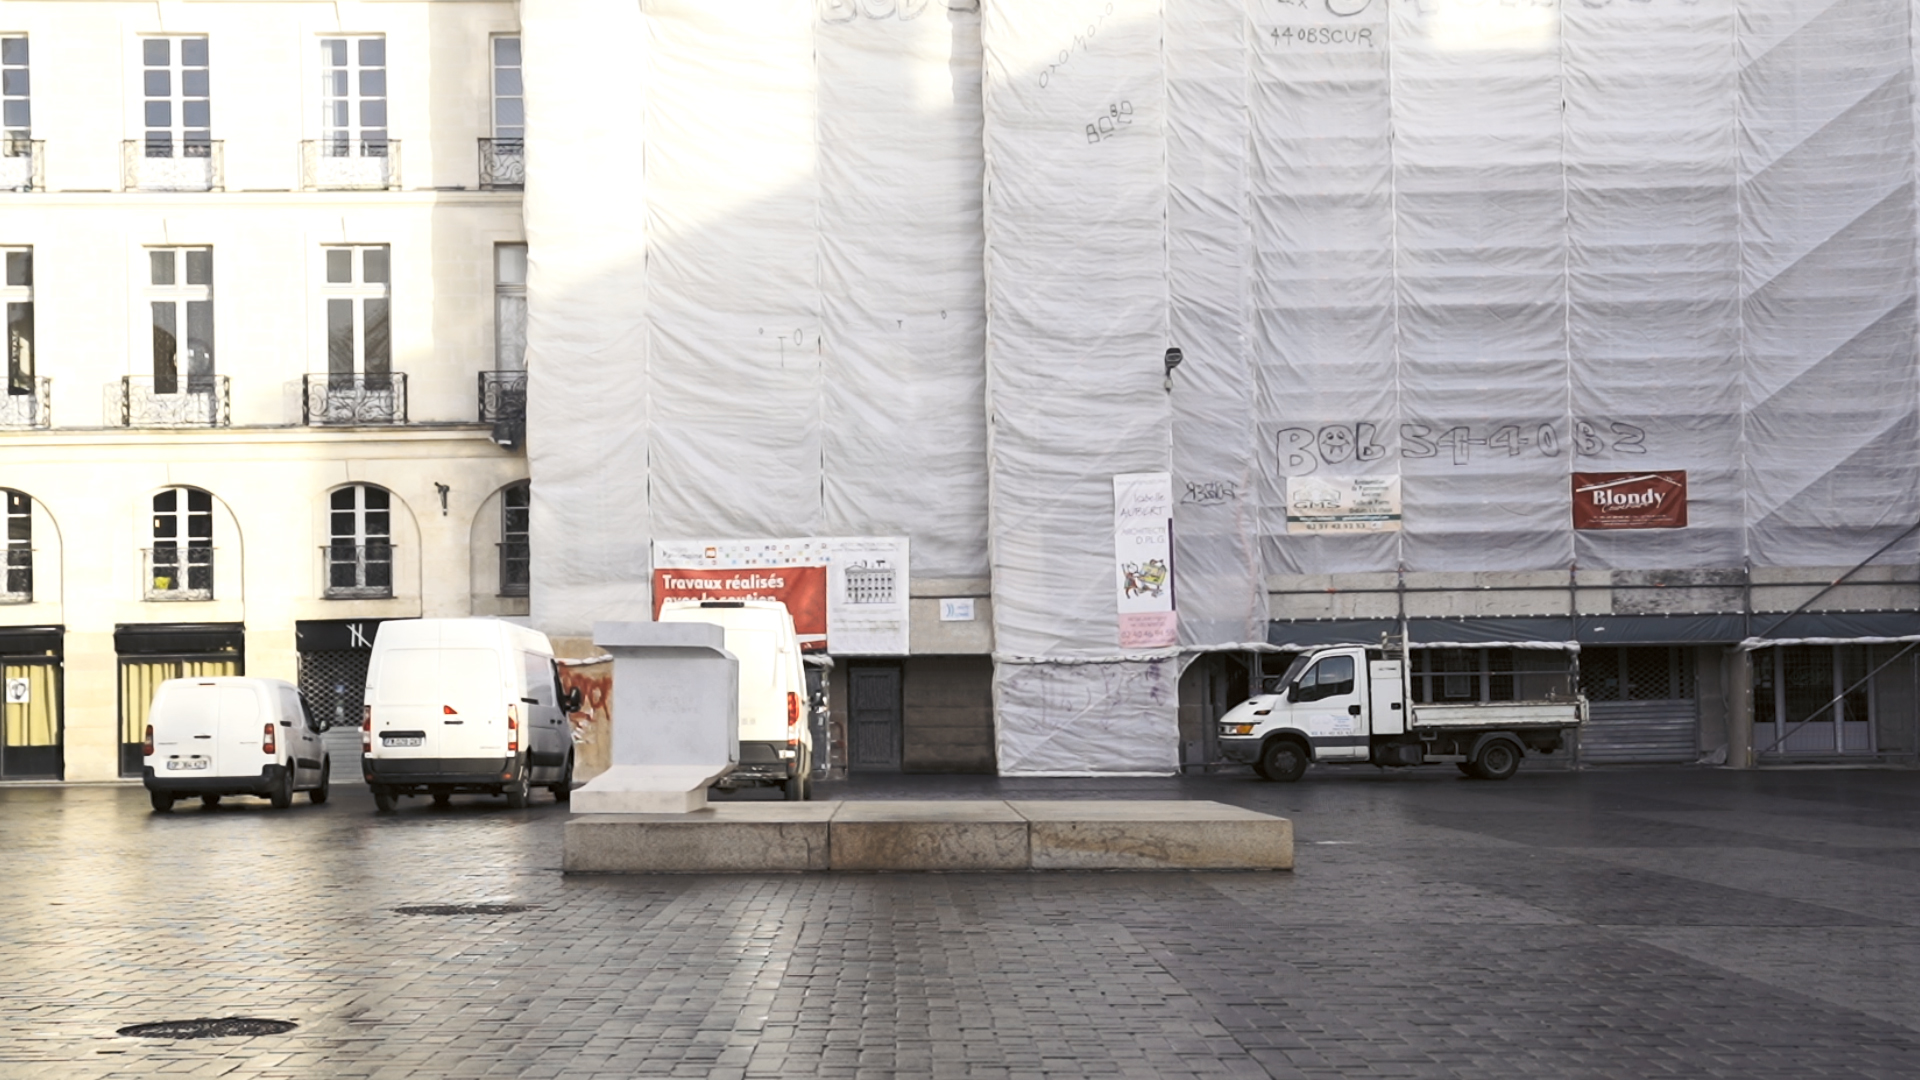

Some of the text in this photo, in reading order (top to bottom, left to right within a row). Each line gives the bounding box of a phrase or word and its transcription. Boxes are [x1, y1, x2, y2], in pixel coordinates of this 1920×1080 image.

[1593, 488, 1666, 509] Blondy
[662, 572, 784, 590] Travaux réalisés
